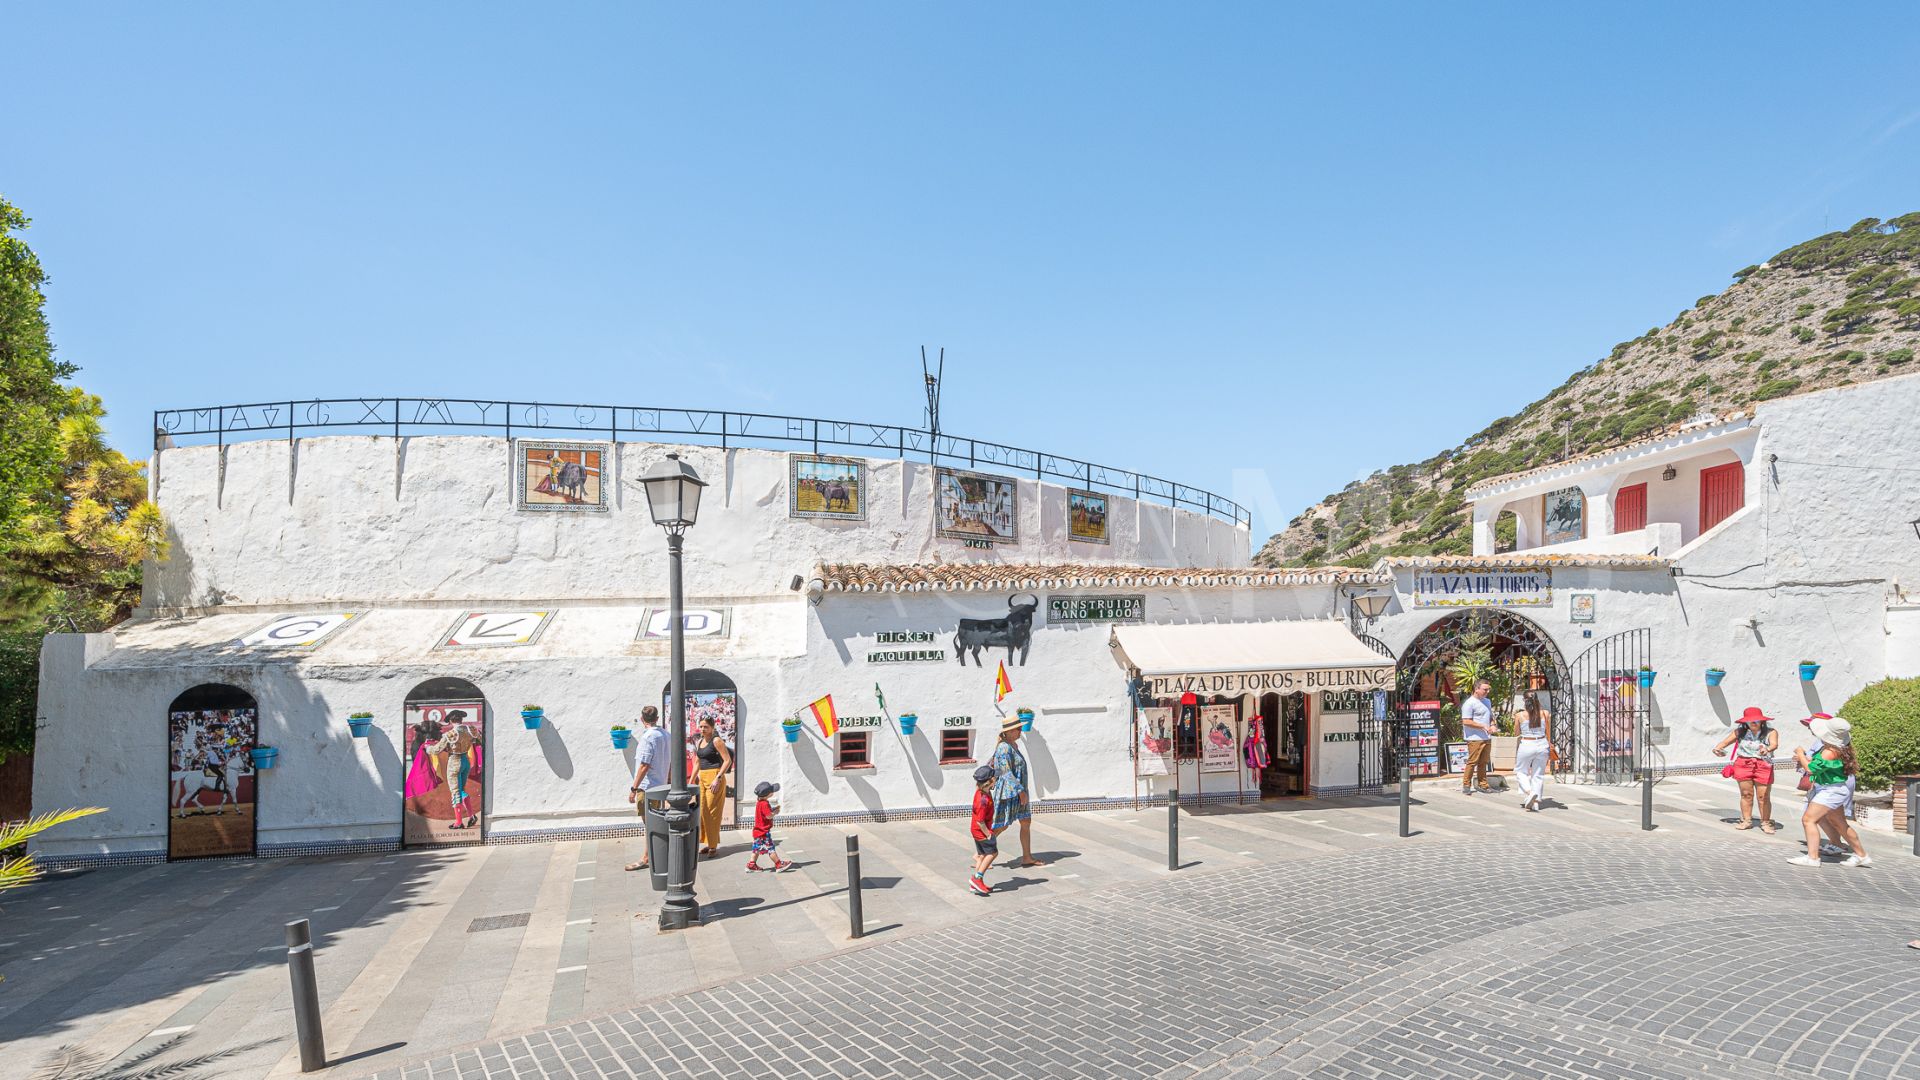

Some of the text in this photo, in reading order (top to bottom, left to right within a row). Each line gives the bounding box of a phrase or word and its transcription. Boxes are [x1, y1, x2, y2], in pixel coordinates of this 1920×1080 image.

[1420, 575, 1540, 595] PLAZA DE TOROS
[1052, 599, 1140, 610] CONSTRUIDA
[1099, 608, 1132, 619] 1900
[877, 632, 933, 643] TICKET
[868, 650, 944, 662] TAQUILLA
[1153, 676, 1208, 694] PLAZA
[1212, 675, 1234, 691] DE
[1238, 672, 1293, 690] TOROS
[1306, 669, 1385, 688] BULLRING
[945, 716, 971, 727] SOL
